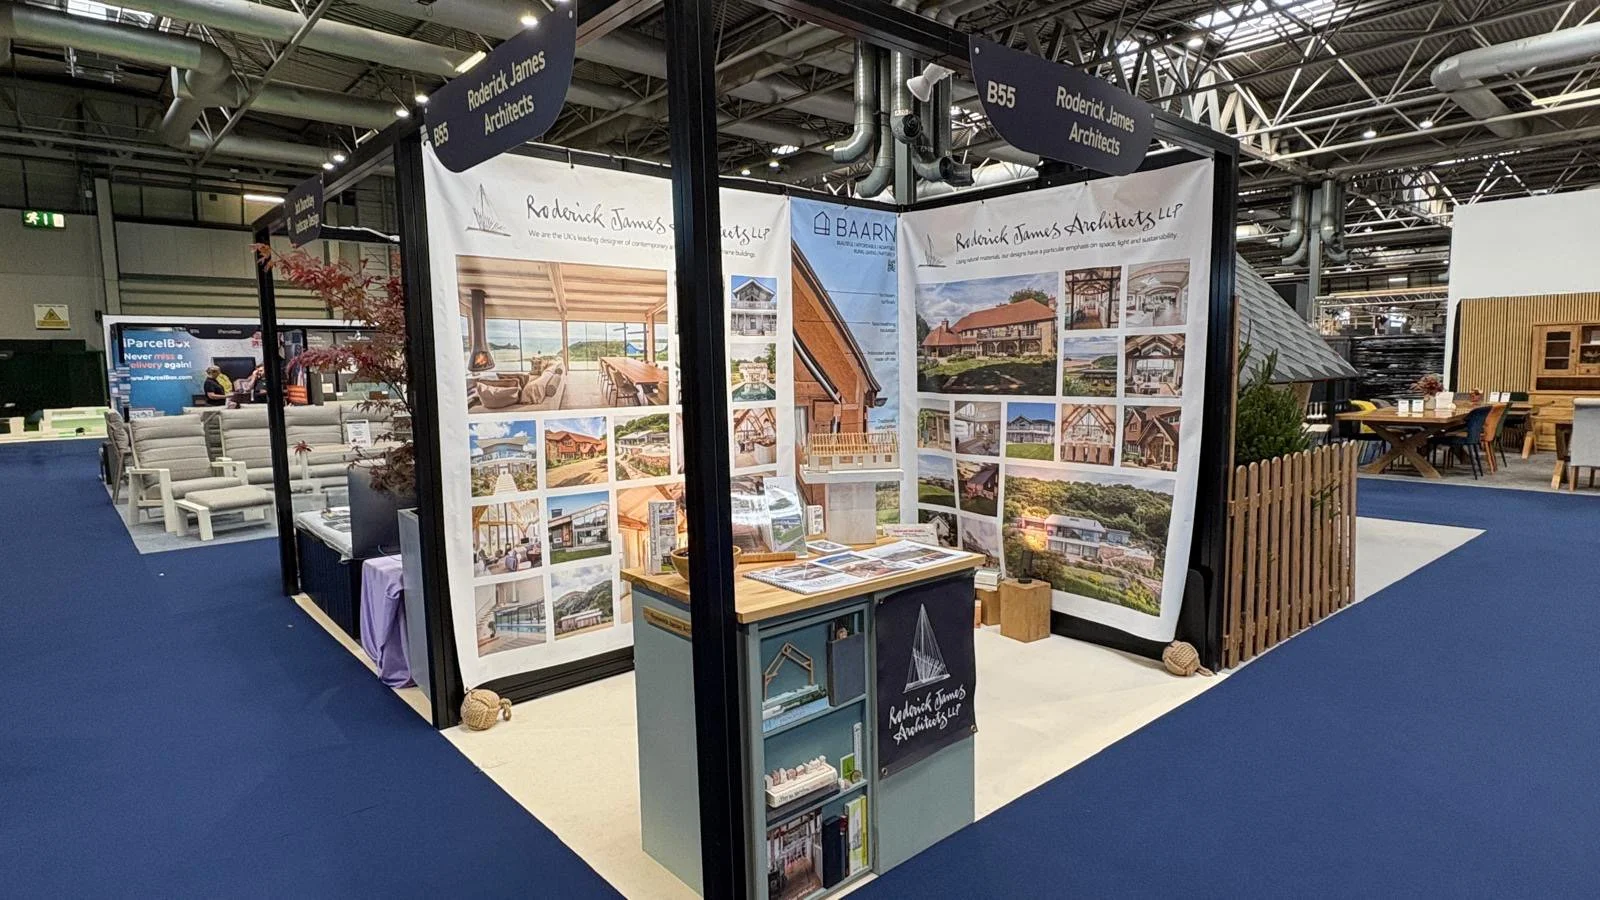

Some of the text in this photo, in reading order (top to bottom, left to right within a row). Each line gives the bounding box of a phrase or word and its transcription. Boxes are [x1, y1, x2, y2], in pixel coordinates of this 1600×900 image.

[468, 51, 546, 111] Roderick James
[987, 80, 1016, 109] B55
[484, 94, 534, 136] Architects
[1056, 86, 1135, 133] Roderick James
[433, 121, 449, 147] B55
[1069, 121, 1121, 156] Architects
[526, 194, 606, 228] Roderick
[611, 207, 667, 235] James
[751, 227, 770, 240] LLP
[836, 217, 896, 243] BAARN
[955, 203, 1184, 253] Roderick James Architects LLP
[528, 229, 540, 238] We
[552, 231, 562, 240] the
[577, 234, 599, 245] leading
[600, 237, 624, 247] designer
[631, 240, 668, 251] contemporary
[1009, 250, 1027, 259] designs
[1027, 248, 1038, 256] have
[1043, 245, 1065, 256] particular
[1099, 241, 1117, 249] space,
[1117, 238, 1130, 248] light
[1130, 236, 1141, 245] and
[124, 352, 153, 360] Never
[153, 352, 176, 360] miss
[130, 361, 192, 370] elivery again!
[888, 684, 966, 730] Roderick James
[893, 703, 961, 746] Architects LLP
